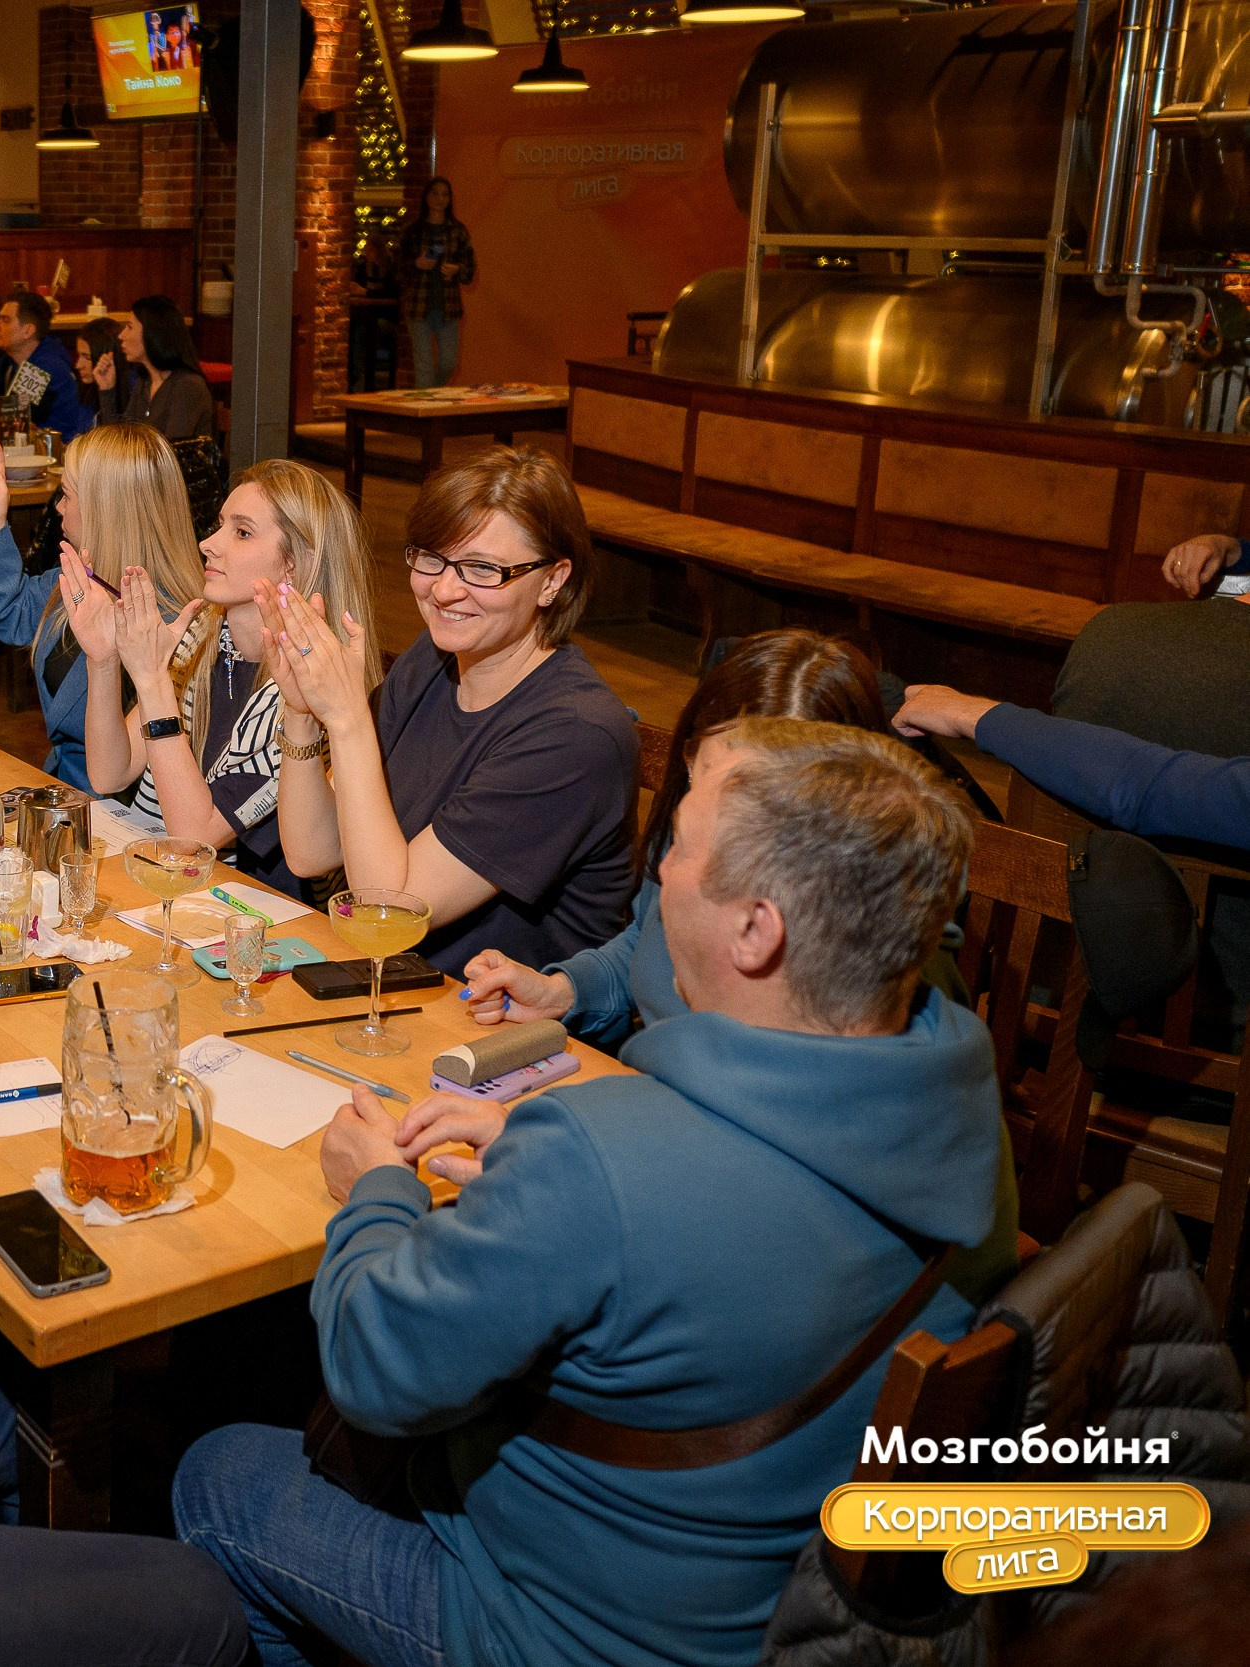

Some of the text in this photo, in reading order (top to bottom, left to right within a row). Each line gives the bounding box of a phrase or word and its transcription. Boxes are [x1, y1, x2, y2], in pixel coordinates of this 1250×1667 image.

[124, 75, 181, 90] Тайна Коко
[516, 141, 684, 170] Корпоративная
[571, 174, 619, 199] лига
